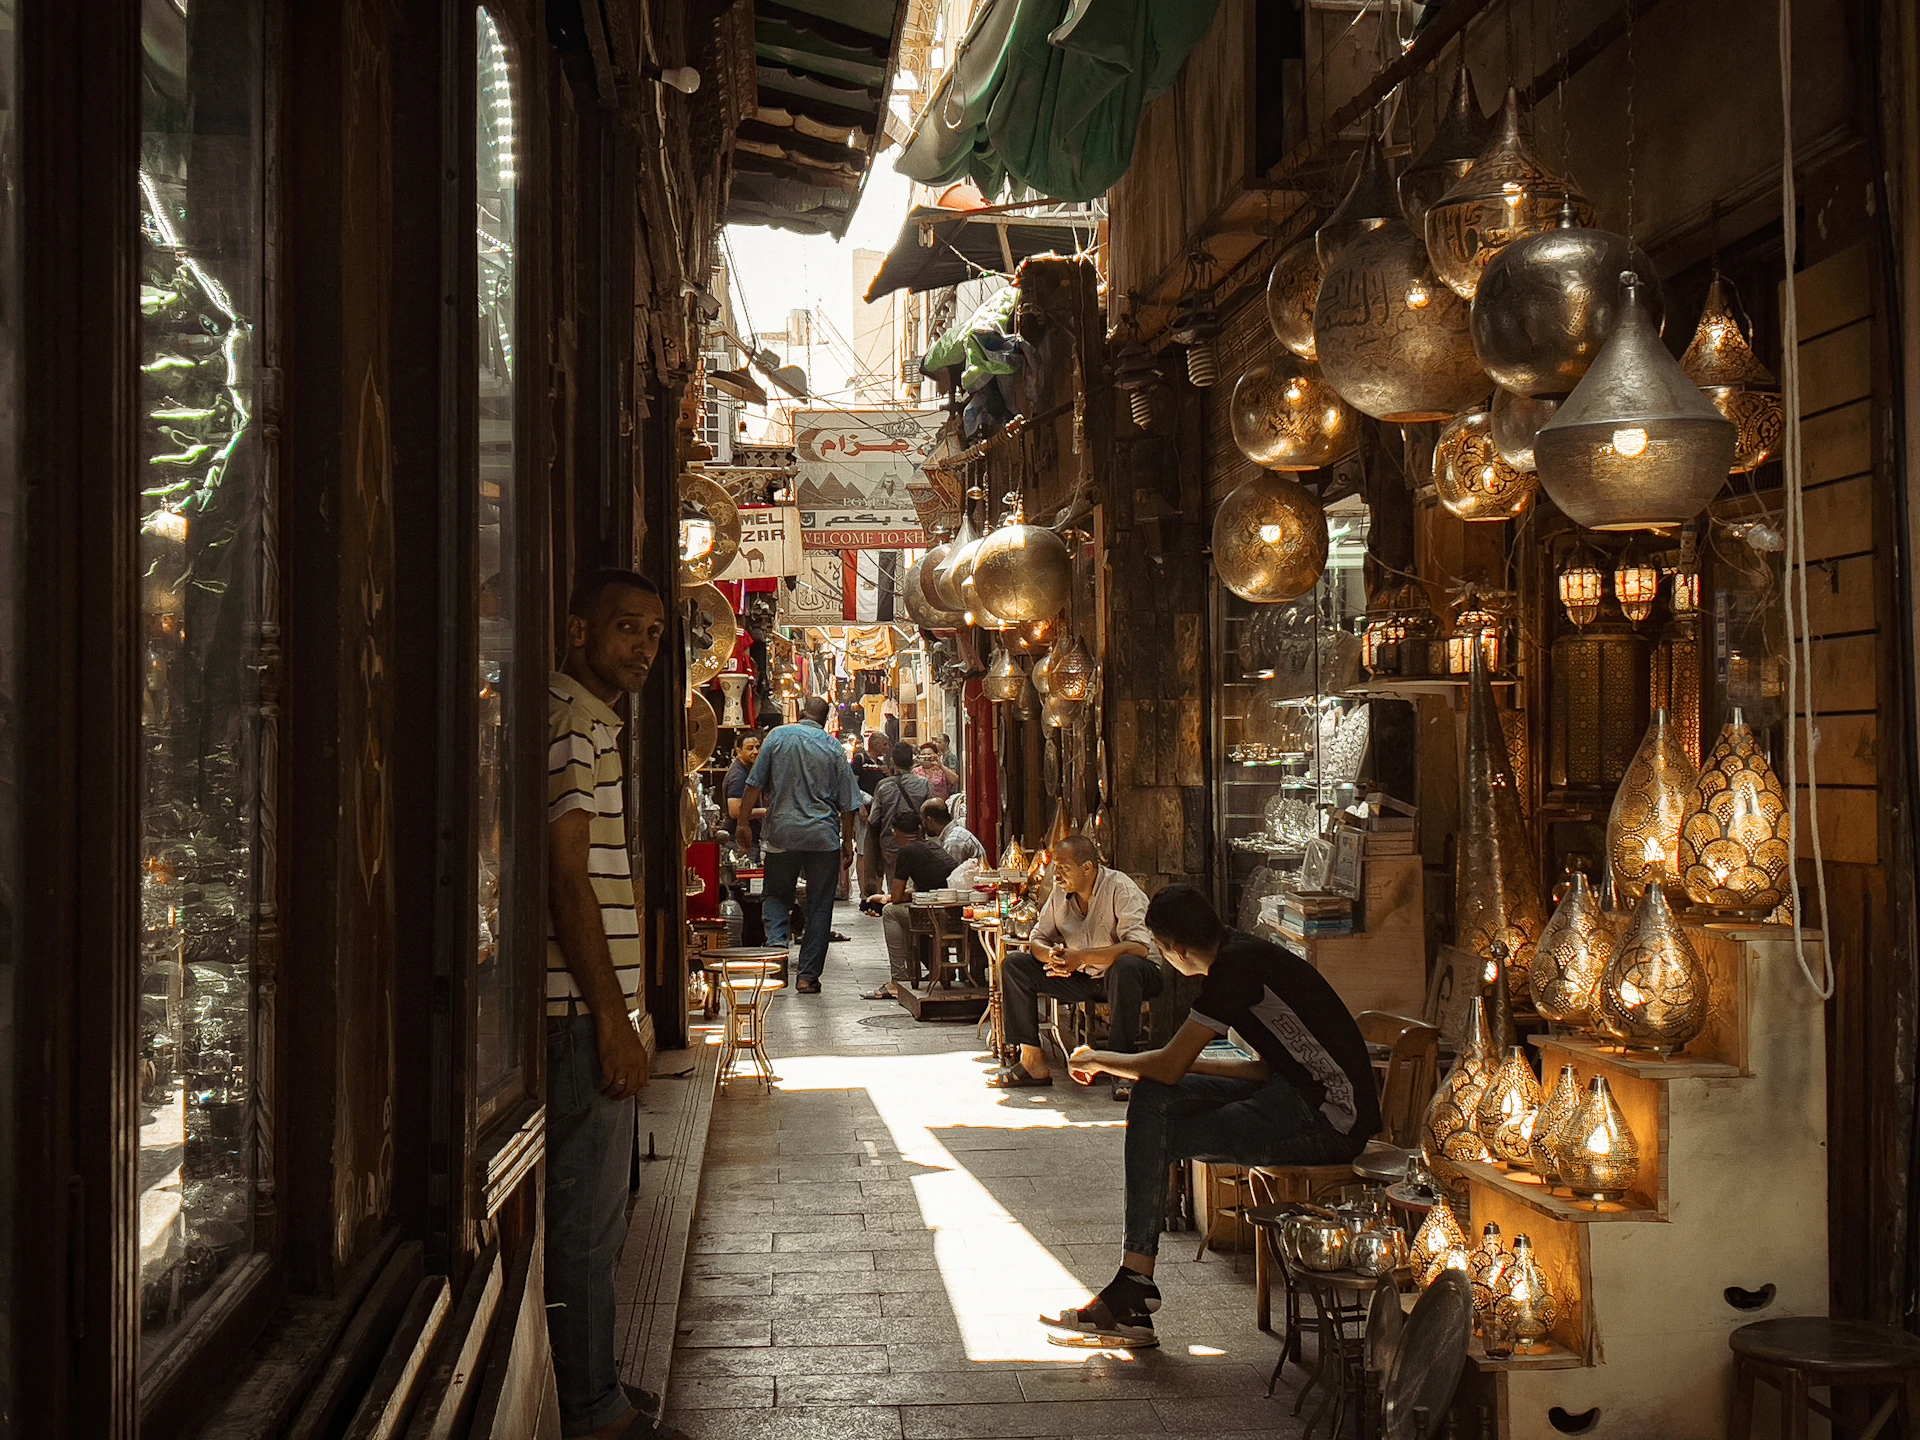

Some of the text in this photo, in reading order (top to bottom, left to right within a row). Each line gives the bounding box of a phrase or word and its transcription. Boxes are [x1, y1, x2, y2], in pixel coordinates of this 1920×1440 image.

[742, 529, 786, 542] ZAR
[877, 532, 899, 545] TO
[904, 531, 928, 544] KH
